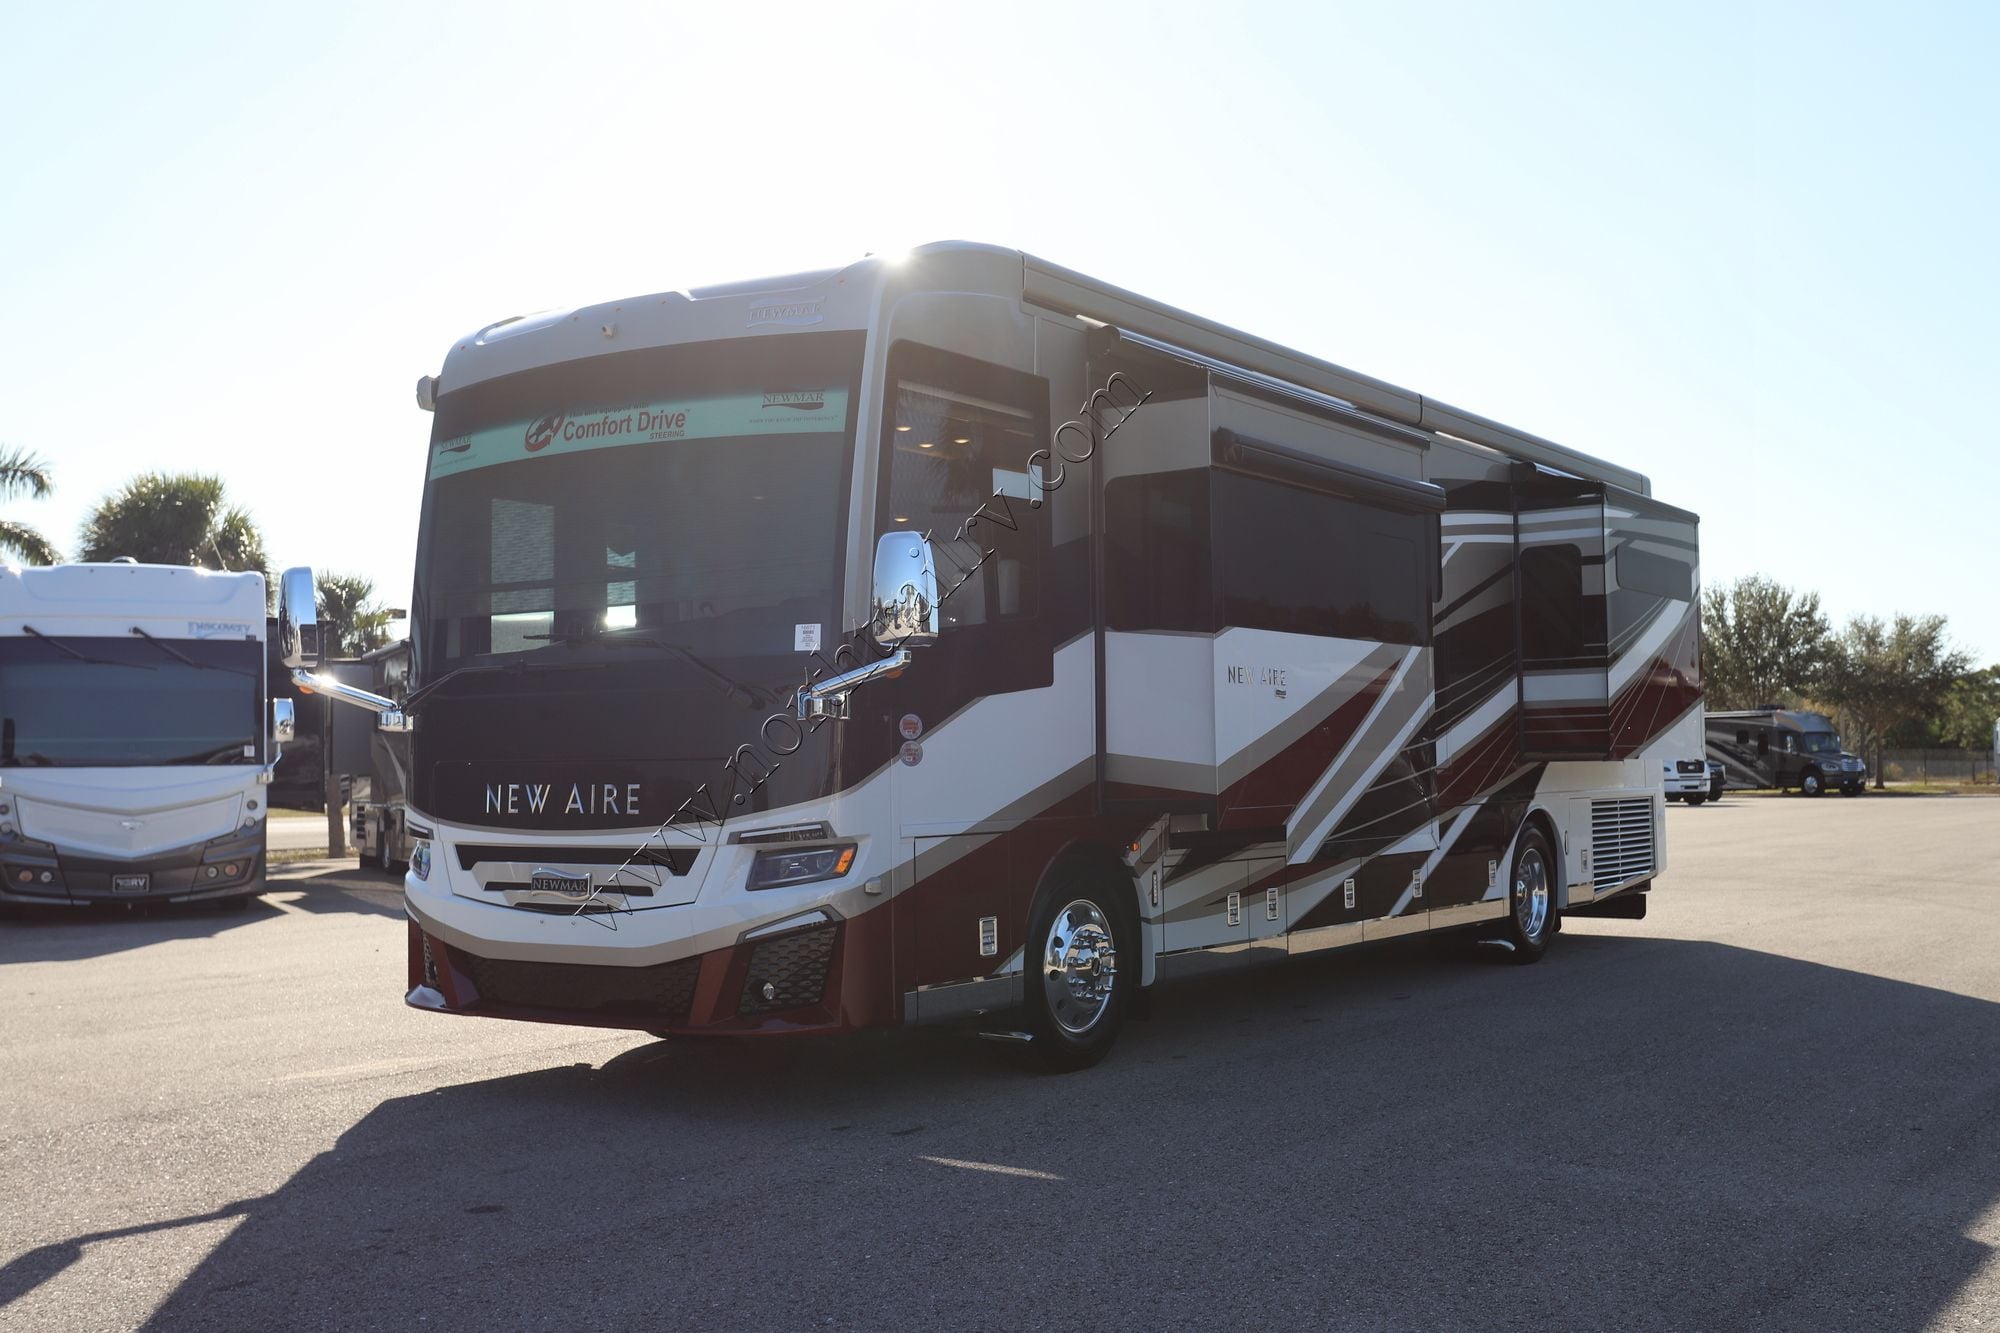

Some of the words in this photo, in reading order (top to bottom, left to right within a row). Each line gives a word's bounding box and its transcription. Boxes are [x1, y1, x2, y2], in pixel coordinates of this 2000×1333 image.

[763, 392, 824, 403] NEWMAR
[563, 413, 633, 441] Comfort
[649, 430, 685, 440] STEERING
[1228, 665, 1255, 684] NEW
[1261, 667, 1286, 686] AIRE
[485, 783, 551, 815] NEW
[564, 782, 641, 815] AIRE
[532, 877, 587, 892] NEWMAR
